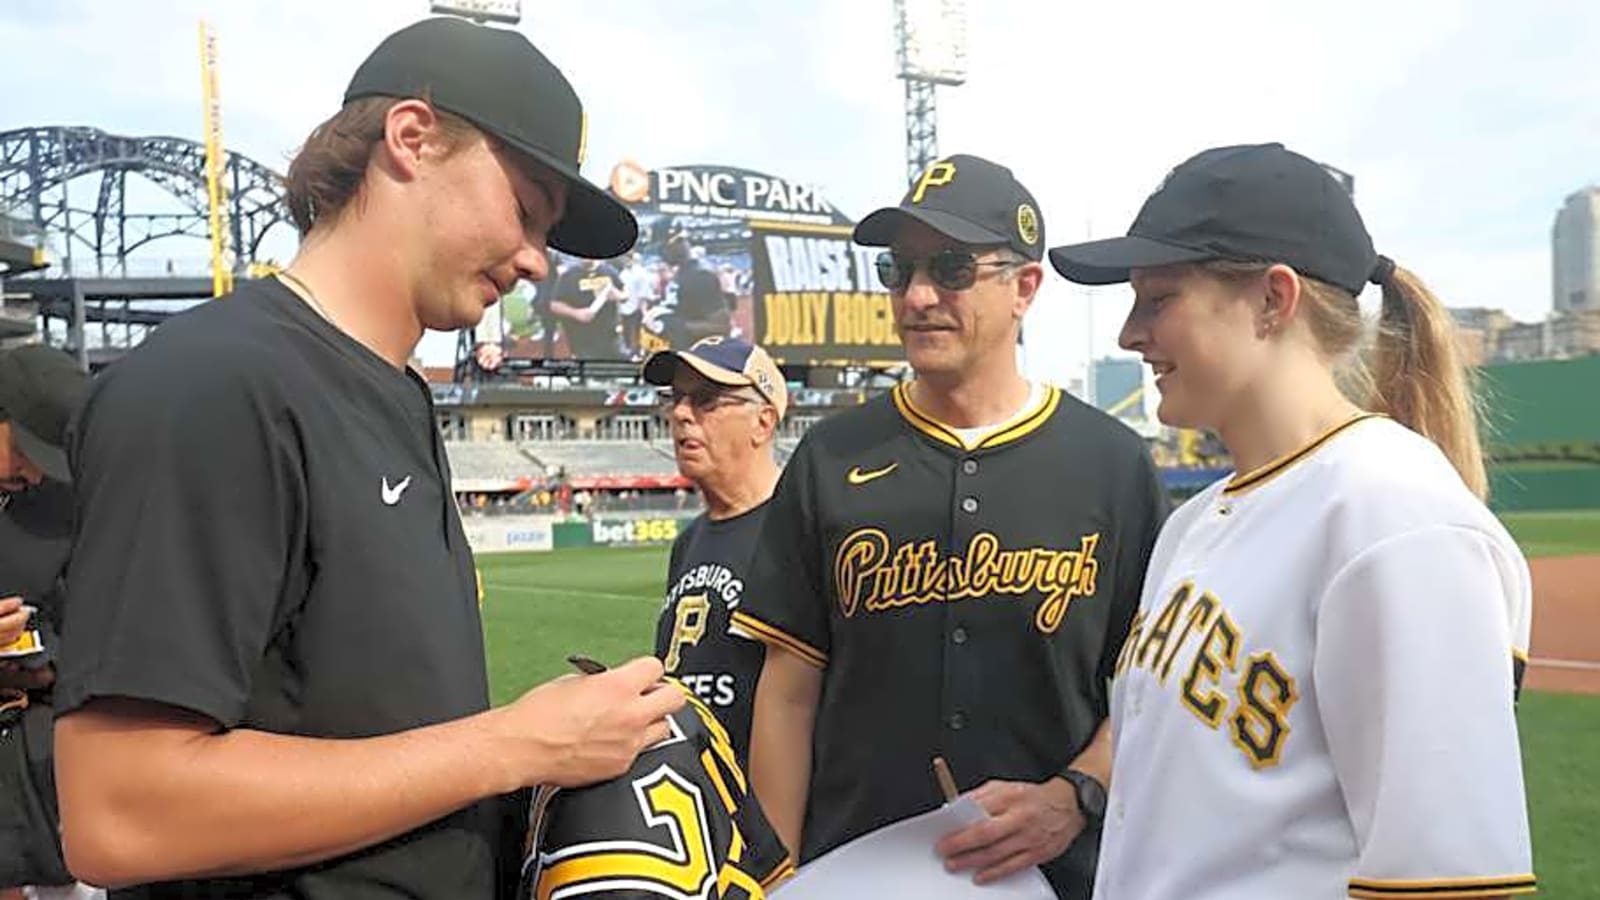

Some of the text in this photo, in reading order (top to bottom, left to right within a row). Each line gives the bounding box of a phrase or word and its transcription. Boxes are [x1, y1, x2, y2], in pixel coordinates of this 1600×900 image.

[657, 169, 833, 213] PNC PARK
[911, 161, 957, 204] P
[764, 235, 854, 292] RAISE
[762, 292, 829, 346] JOLLY
[592, 517, 678, 543] bet365
[835, 528, 1099, 633] Pittsburgh
[664, 591, 711, 673] P
[680, 673, 736, 707] TES
